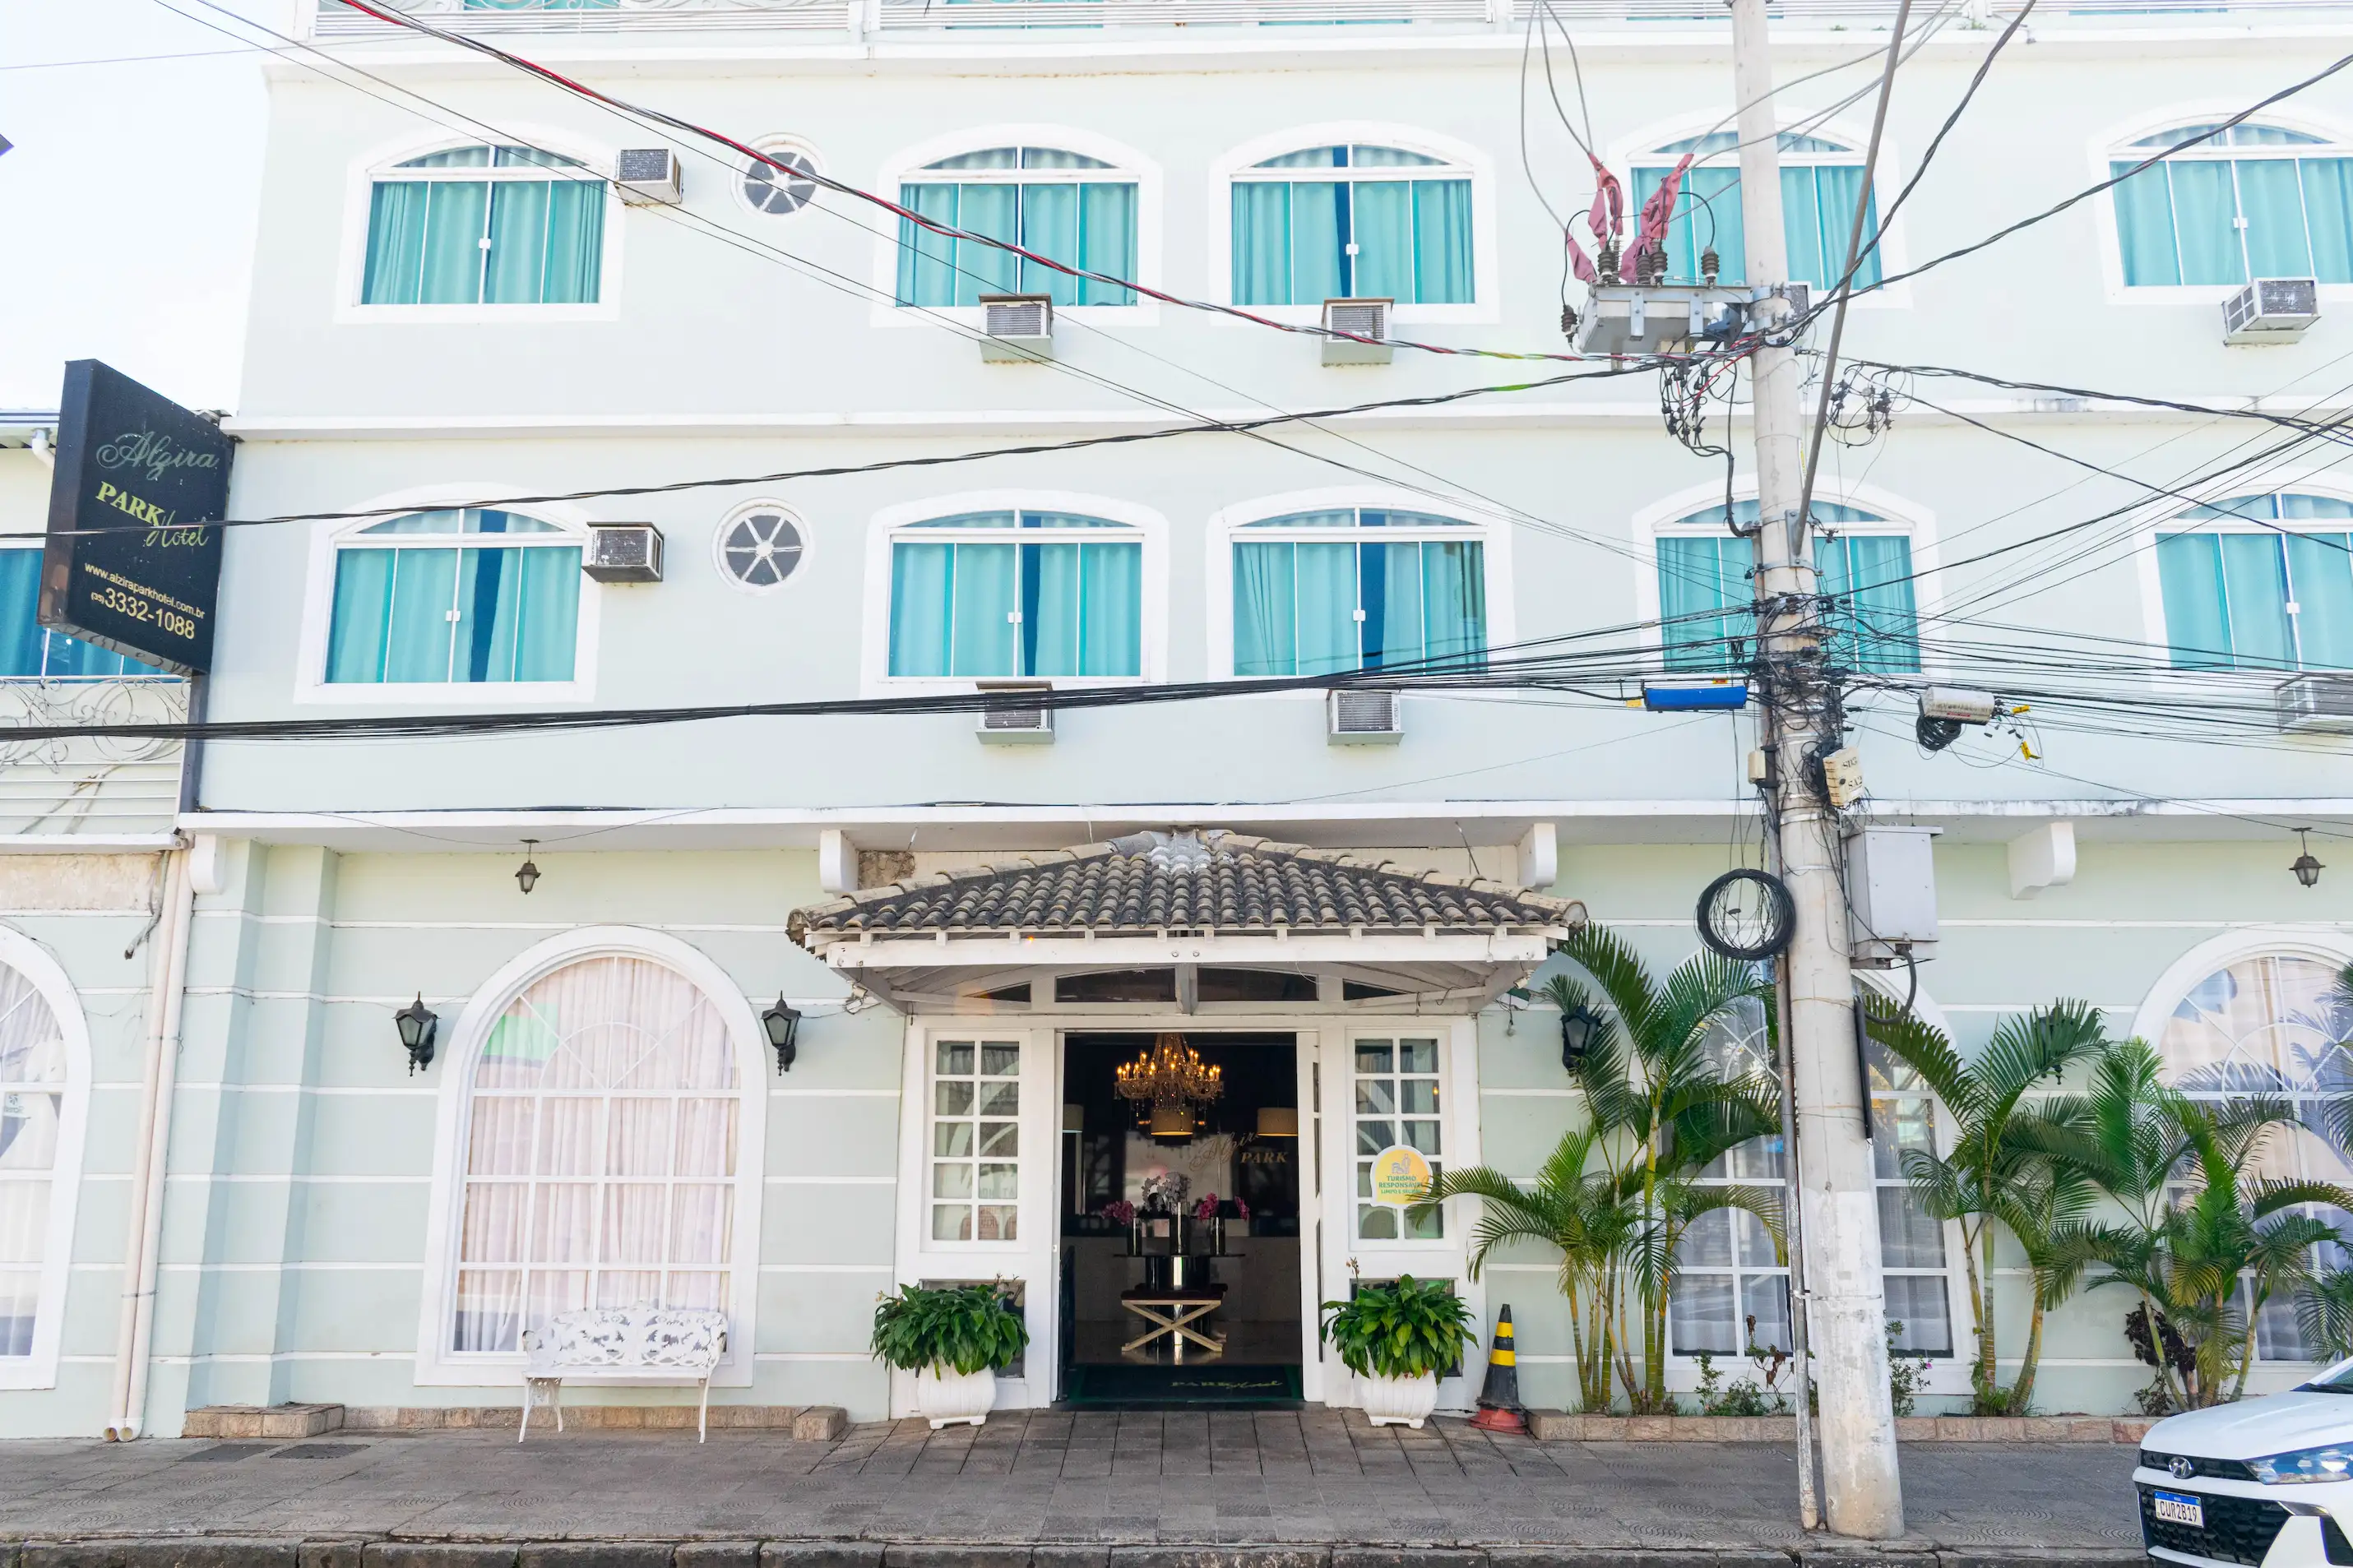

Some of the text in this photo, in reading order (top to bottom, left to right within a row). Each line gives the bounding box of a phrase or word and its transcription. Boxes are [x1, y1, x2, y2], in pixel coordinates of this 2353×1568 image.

[96, 431, 220, 480] Alzira
[95, 481, 164, 526] PARK
[146, 510, 209, 548] Hotel
[84, 562, 206, 619] www.alziraparkhotel.com.br
[104, 587, 195, 640] 3332-1088
[1240, 1151, 1289, 1164] PARK
[2160, 1501, 2197, 1523] CUR2B19
